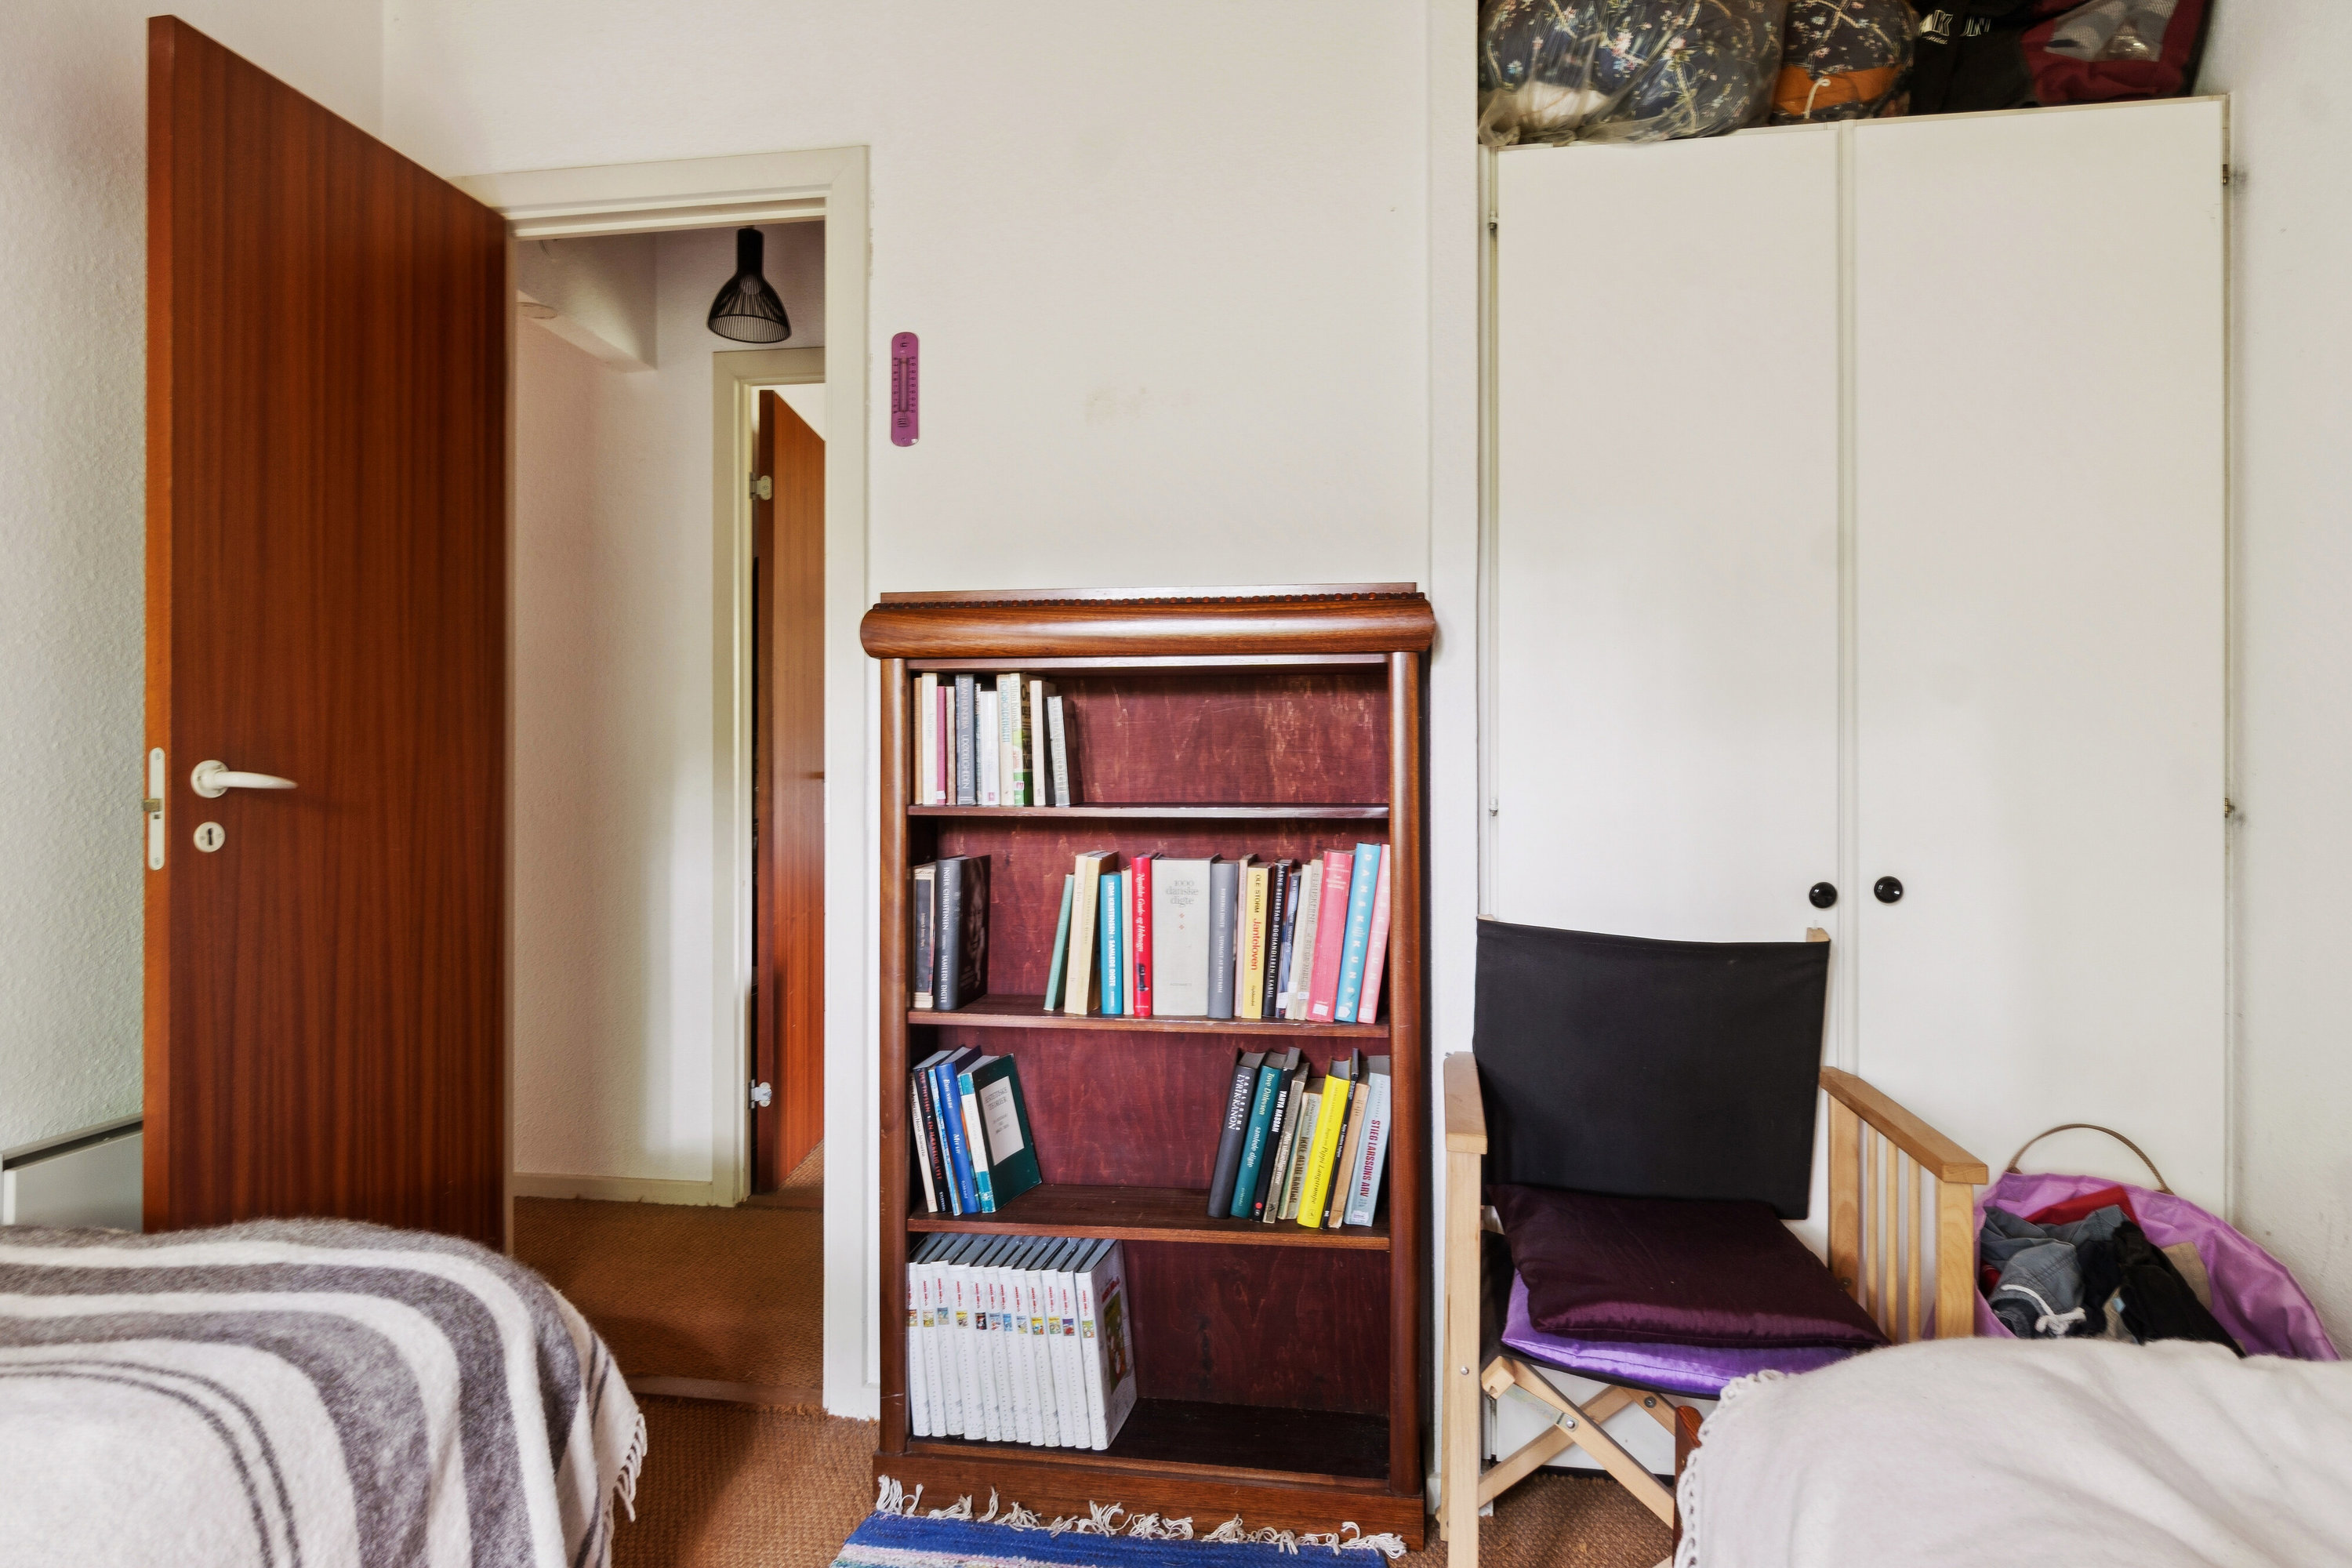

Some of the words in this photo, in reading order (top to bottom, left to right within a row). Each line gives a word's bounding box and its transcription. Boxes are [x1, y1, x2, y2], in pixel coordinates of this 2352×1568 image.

[960, 678, 968, 699] MILAN
[1010, 680, 1018, 701] Milan
[1011, 702, 1019, 732] Kundera
[1356, 854, 1372, 923] DANSK
[1273, 887, 1282, 921] SEIERSTAD
[1250, 917, 1261, 970] Janteloven
[1269, 924, 1279, 973] BOGHANDLEREN
[1346, 941, 1361, 1008] KUNST
[1264, 1072, 1275, 1087] Tove
[920, 1085, 931, 1112] THYSSEN
[1258, 1087, 1271, 1116] Ditlevsen
[1276, 1090, 1287, 1109] YAHYA
[927, 1120, 933, 1130] EN
[1271, 1109, 1283, 1132] HASSAN
[1368, 1120, 1381, 1141] STIEG
[928, 1131, 939, 1164] MÆRKELIG
[1250, 1126, 1262, 1152] samlede
[1283, 1131, 1292, 1145] Min
[1245, 1151, 1257, 1168] digte
[1317, 1145, 1328, 1163] Pippi
[1362, 1142, 1377, 1181] LARSSONS
[1309, 1163, 1324, 1204] Langstrømpe
[1359, 1181, 1370, 1197] ARV
